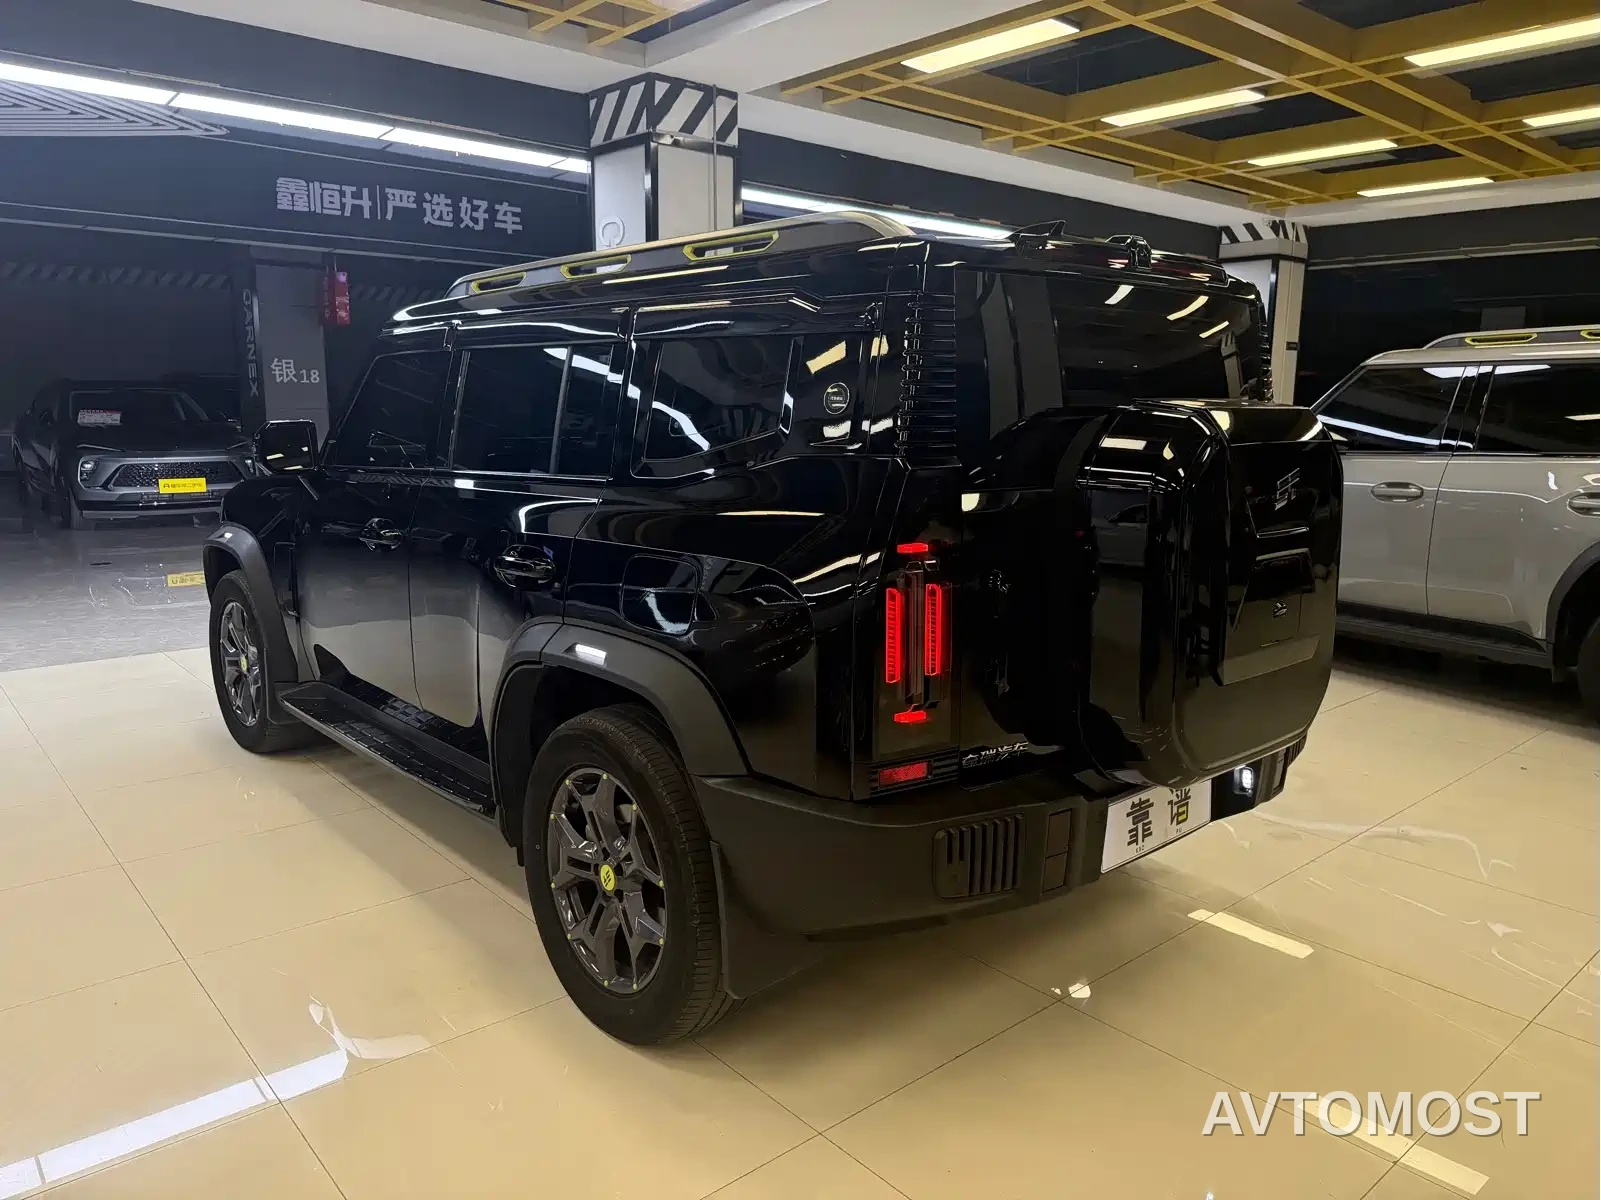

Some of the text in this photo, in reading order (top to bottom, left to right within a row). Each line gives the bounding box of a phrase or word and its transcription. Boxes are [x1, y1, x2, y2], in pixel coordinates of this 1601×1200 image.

[276, 176, 523, 235] 鑫恒升 严选好车
[243, 289, 259, 397] CARNEX
